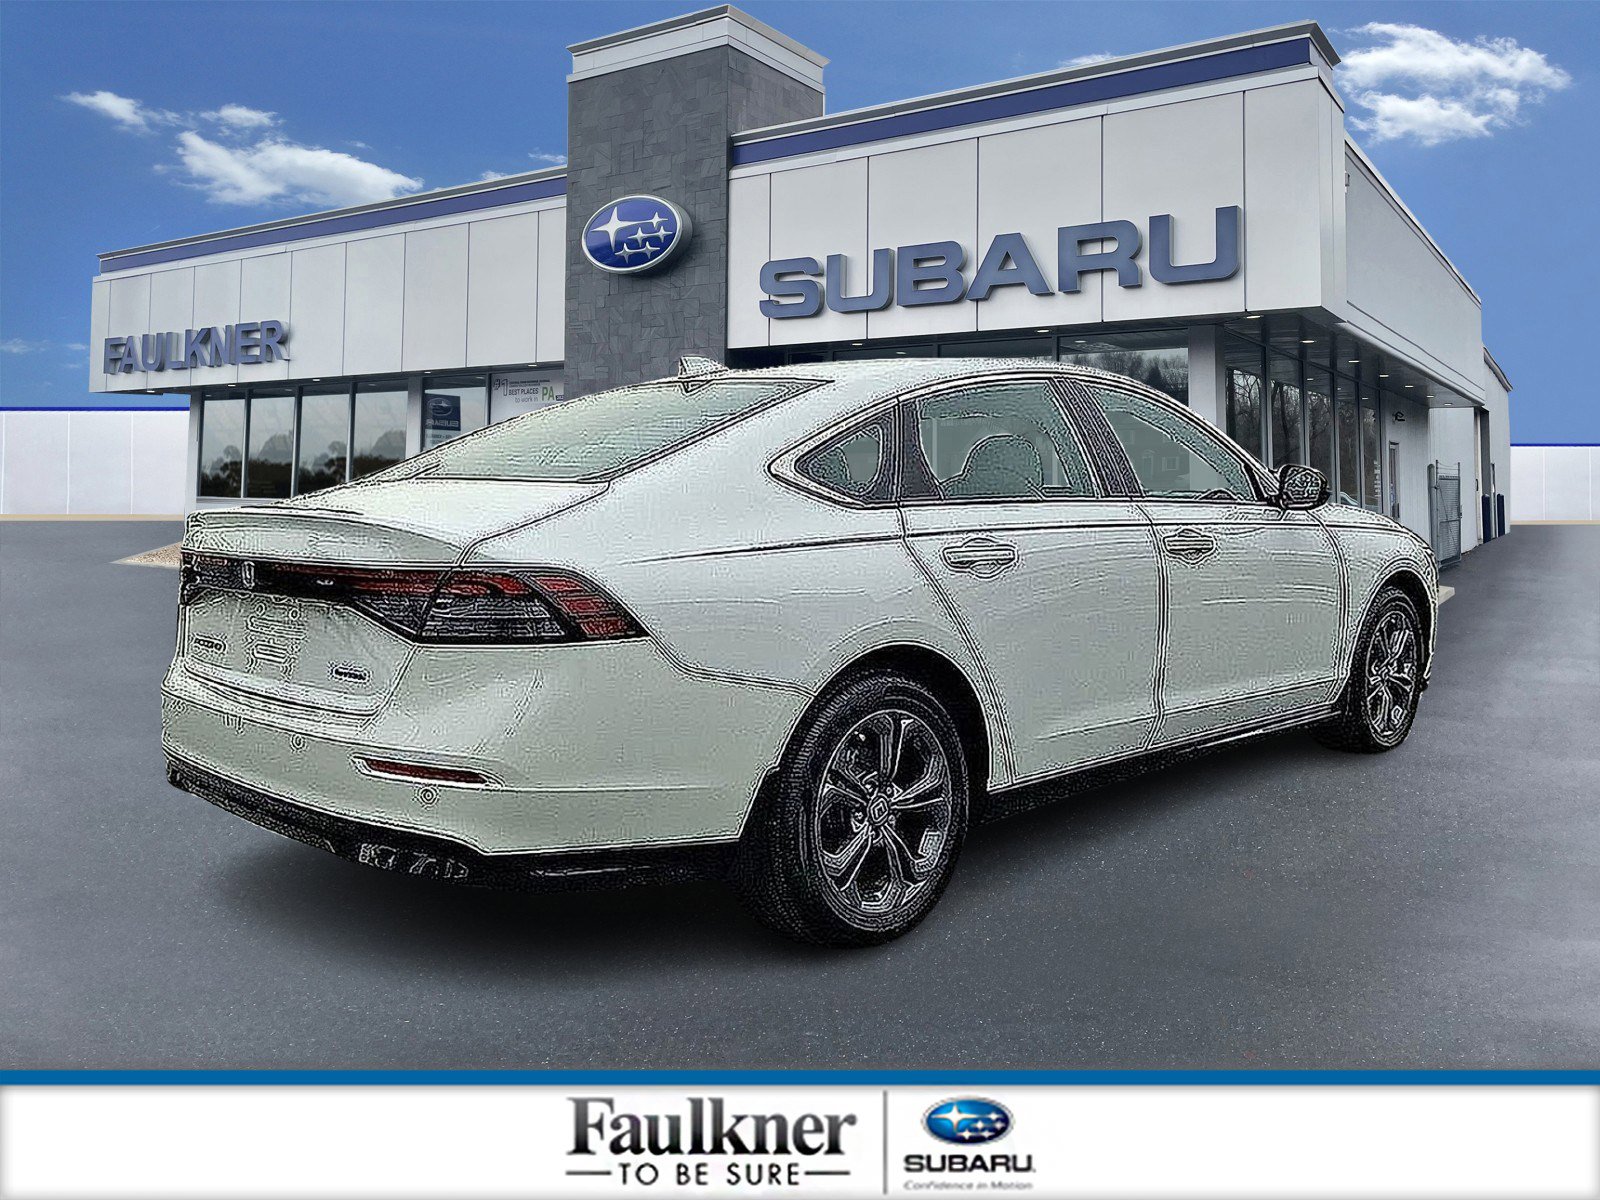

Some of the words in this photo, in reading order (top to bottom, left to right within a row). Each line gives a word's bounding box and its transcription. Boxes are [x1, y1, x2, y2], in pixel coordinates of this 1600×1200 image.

[759, 205, 1242, 319] SUBARU
[103, 319, 290, 375] FAULKNER
[509, 388, 520, 396] BEST
[521, 387, 539, 395] PLACES
[541, 386, 555, 401] PA
